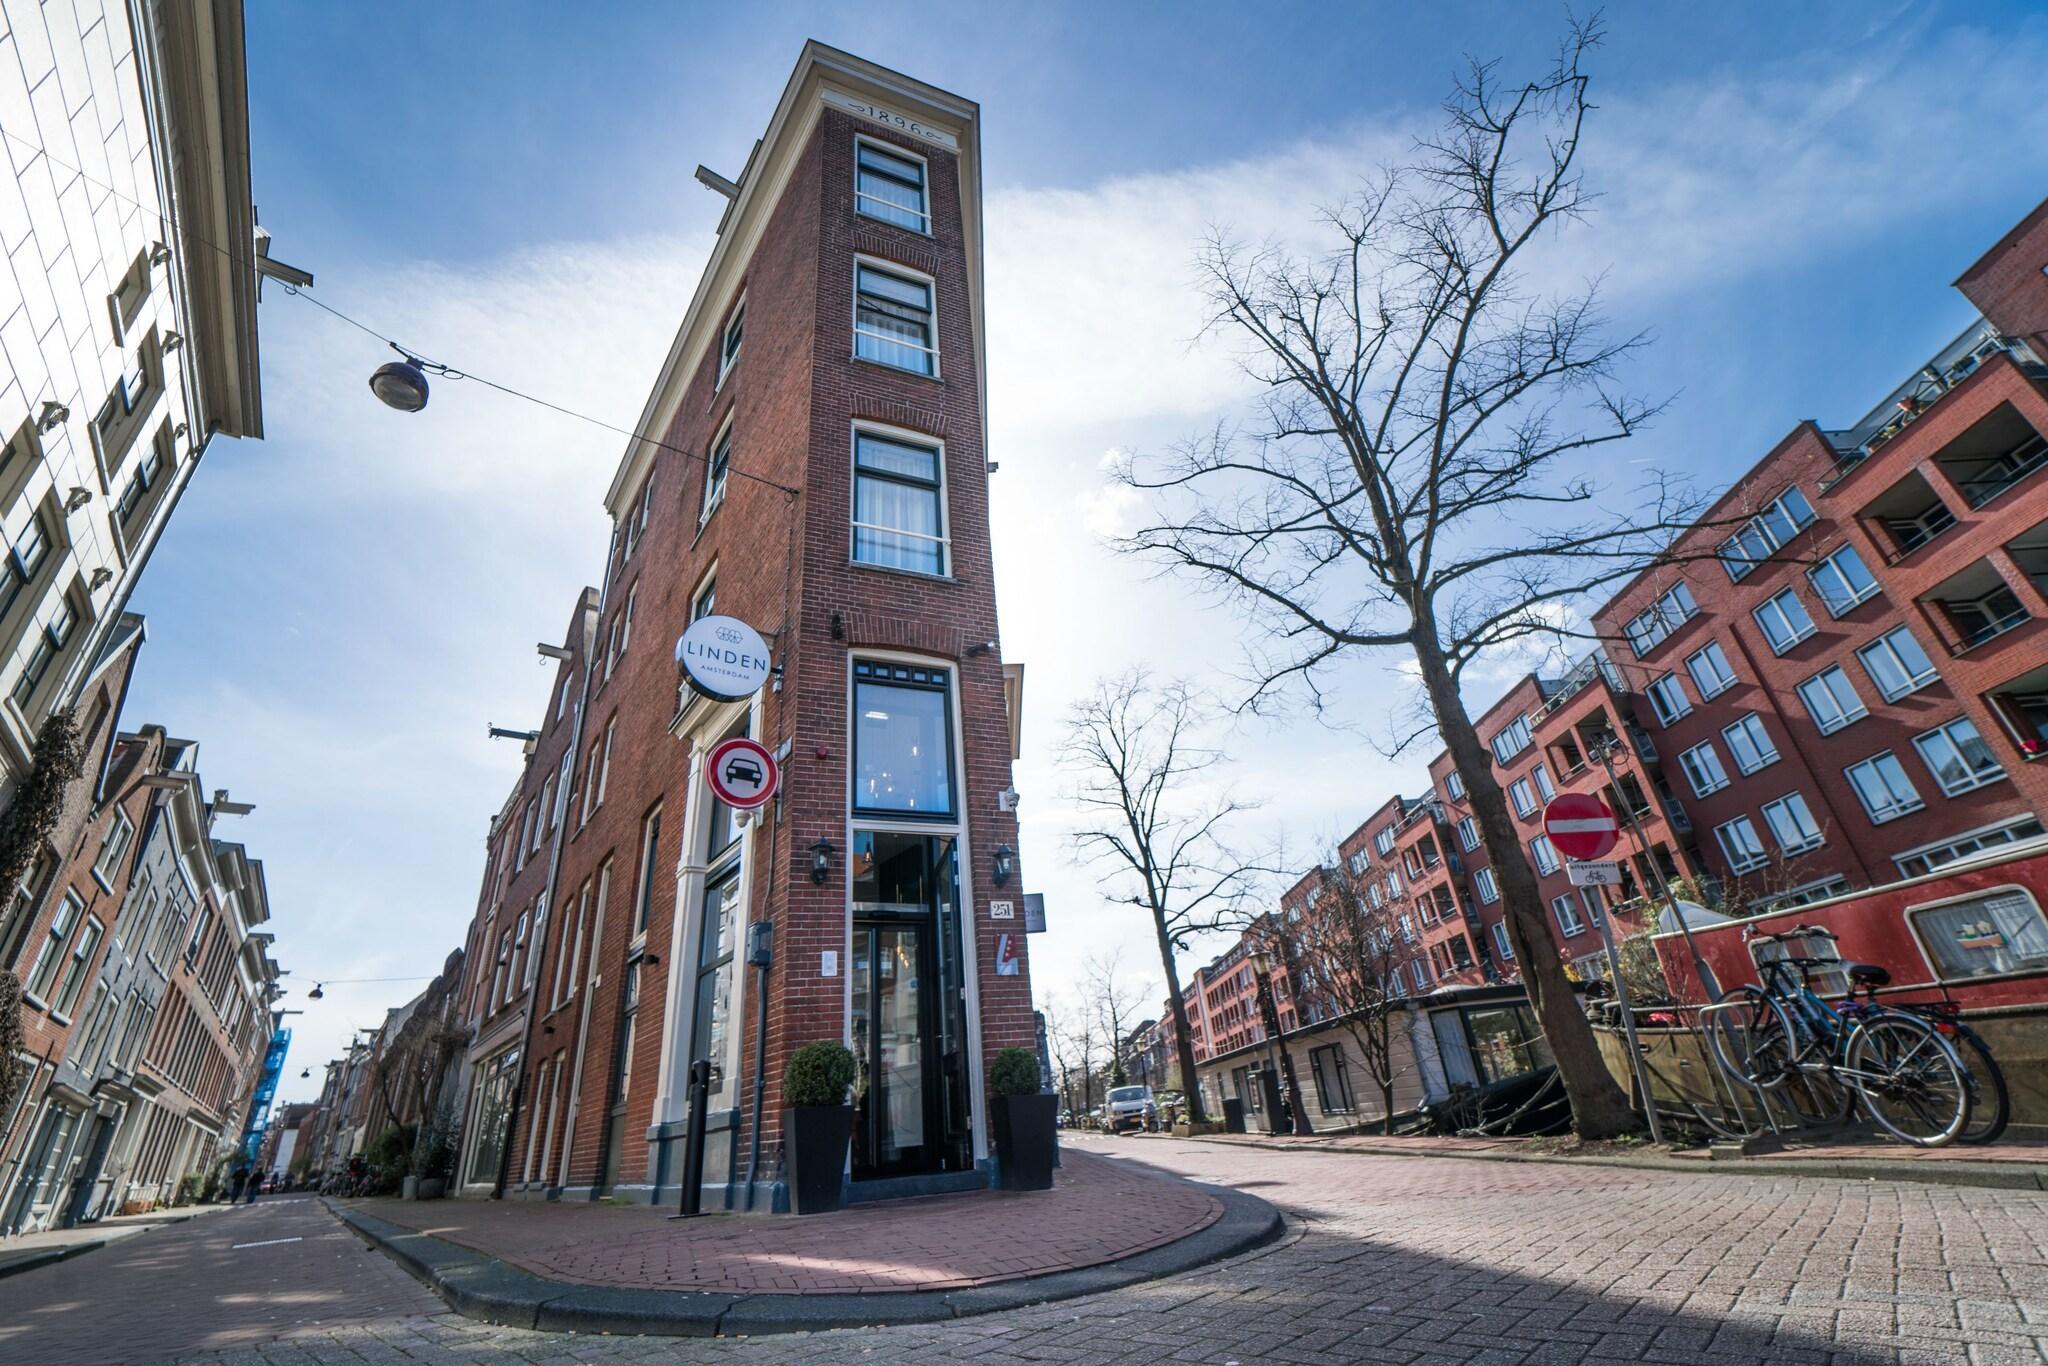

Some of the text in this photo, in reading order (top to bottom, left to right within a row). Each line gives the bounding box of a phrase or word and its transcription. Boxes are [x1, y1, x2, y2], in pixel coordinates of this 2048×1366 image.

[869, 106, 921, 135] 1896
[687, 641, 766, 672] LINDEN
[700, 664, 751, 680] AMSTERDAM
[993, 904, 1011, 916] 251
